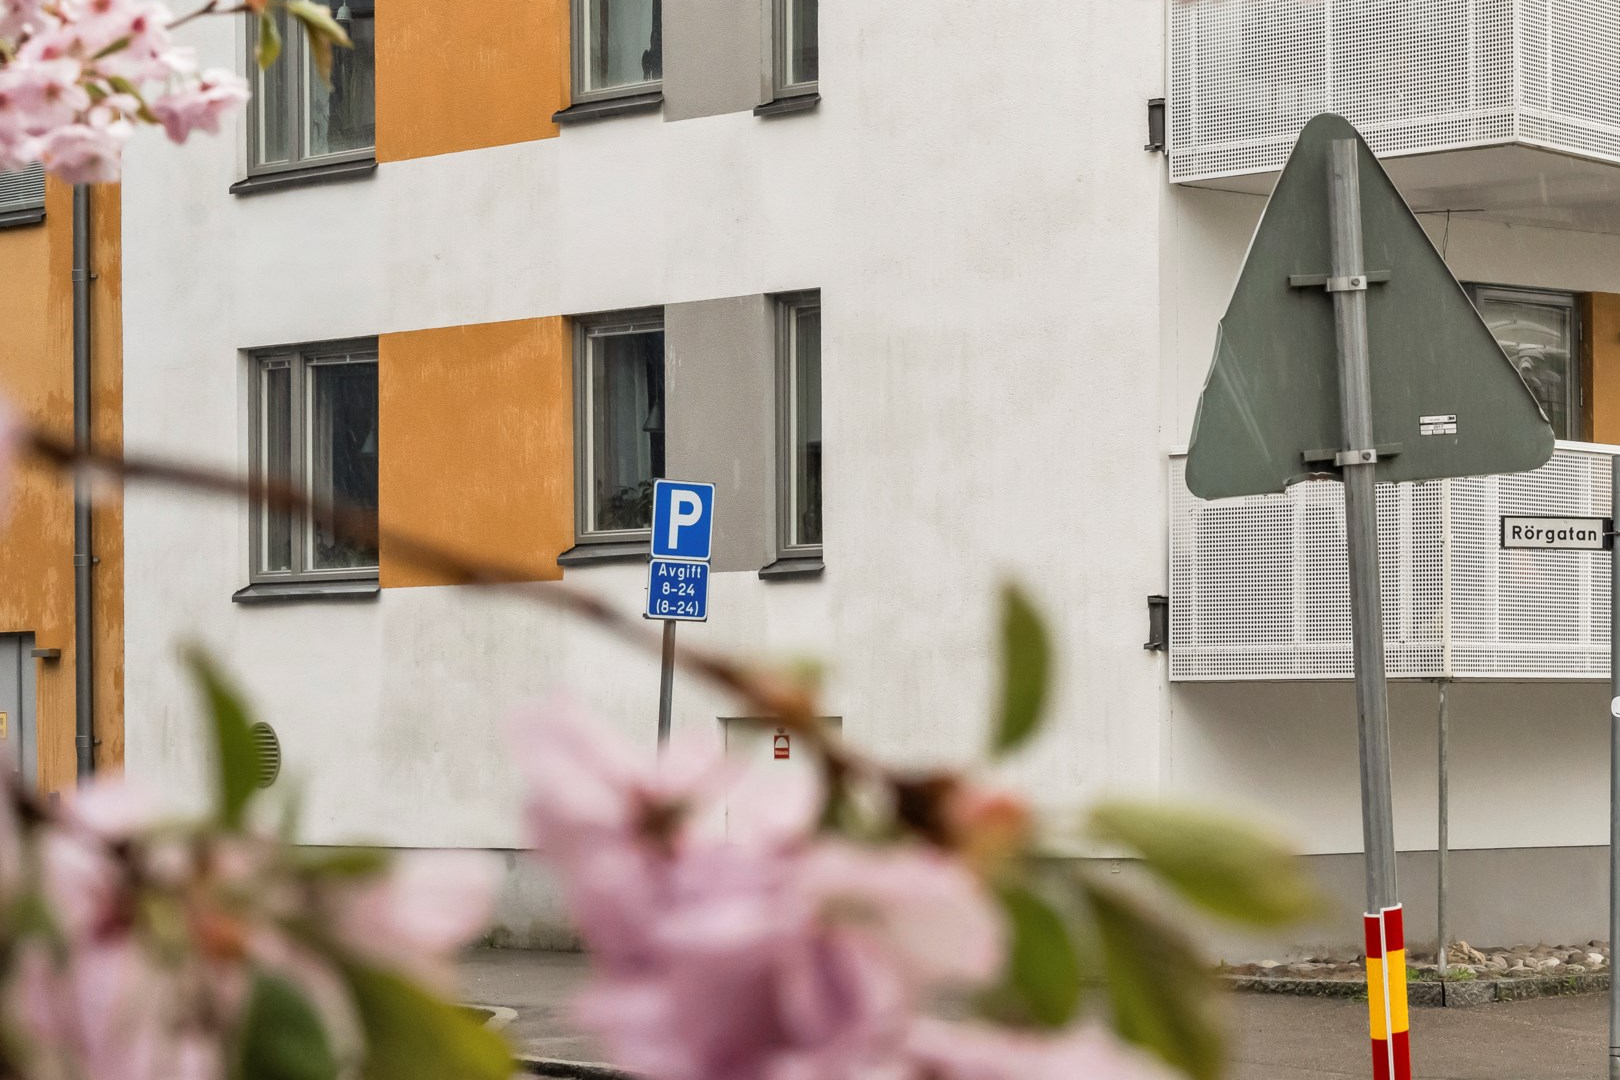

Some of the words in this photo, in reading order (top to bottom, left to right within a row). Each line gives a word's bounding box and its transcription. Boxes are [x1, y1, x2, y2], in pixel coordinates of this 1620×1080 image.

[668, 489, 703, 550] P
[1512, 525, 1597, 543] Rörgatan
[658, 563, 701, 580] Avgift
[662, 582, 695, 596] 8-24
[656, 598, 699, 616] (8-24)
